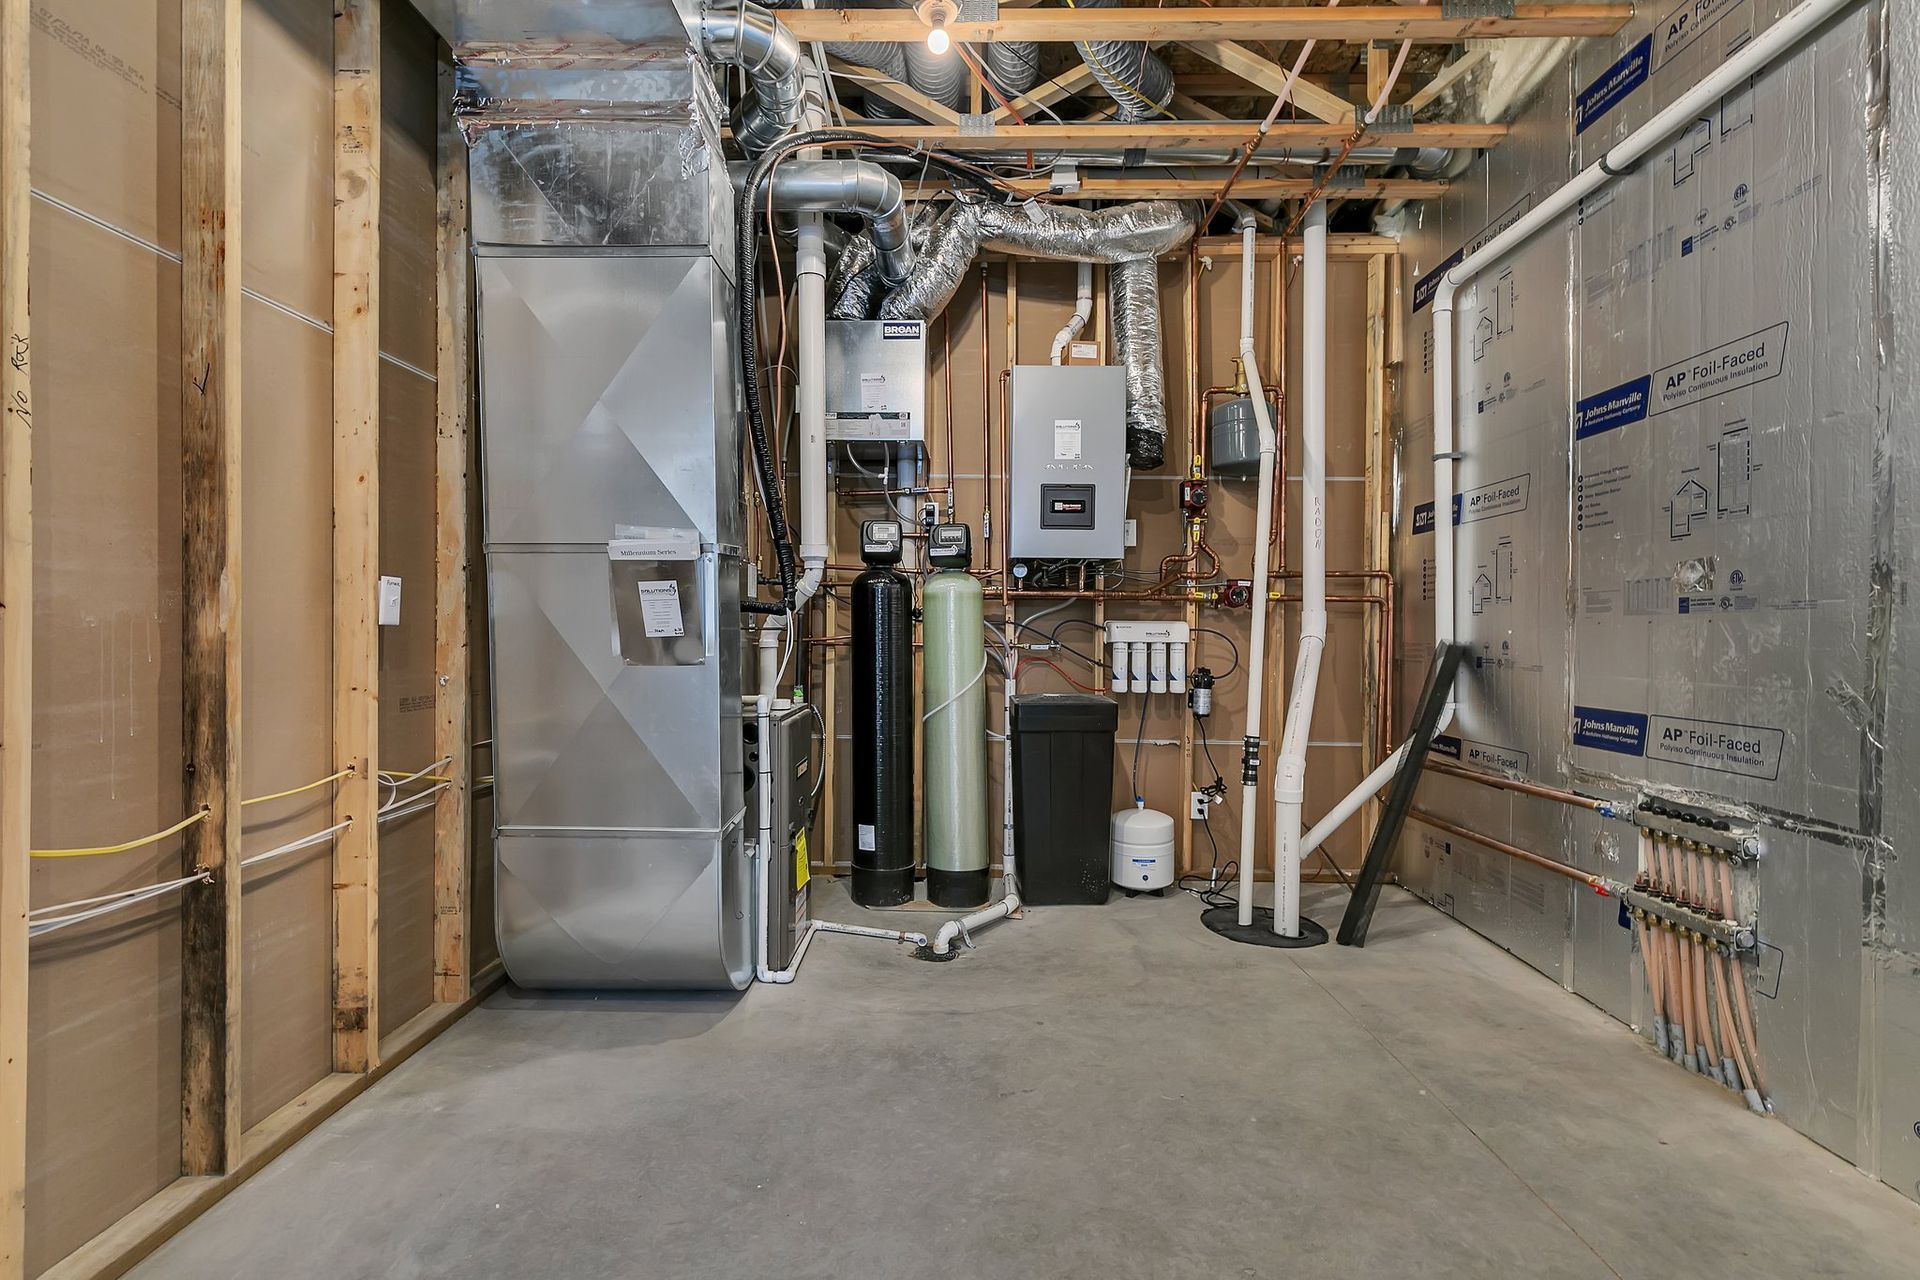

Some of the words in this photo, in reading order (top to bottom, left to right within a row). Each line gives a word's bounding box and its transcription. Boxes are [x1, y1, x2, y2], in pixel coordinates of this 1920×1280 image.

[1667, 13, 1689, 40] AP
[1585, 81, 1608, 111] Johns
[1608, 54, 1644, 91] Manville
[884, 325, 920, 334] BROAN
[1665, 372, 1686, 390] AP
[1692, 342, 1765, 380] Foil-Faced
[1663, 388, 1687, 402] Polyiso
[1688, 374, 1729, 394] Continuous
[1730, 360, 1769, 380] Insulation
[1585, 404, 1608, 421] Johns
[1608, 391, 1642, 411] Manville
[1470, 496, 1481, 507] AP
[1483, 485, 1520, 504] Foil-Faced
[1582, 719, 1605, 732] Johns
[1605, 723, 1639, 736] Manville
[1662, 727, 1683, 741] AP
[1689, 731, 1761, 754] Foil-Faced
[1469, 749, 1480, 759] AP
[1483, 751, 1518, 769] Foil-Faced
[1660, 742, 1684, 755] Polyiso
[1684, 746, 1725, 761] Continuous
[1726, 753, 1765, 767] Insulation
